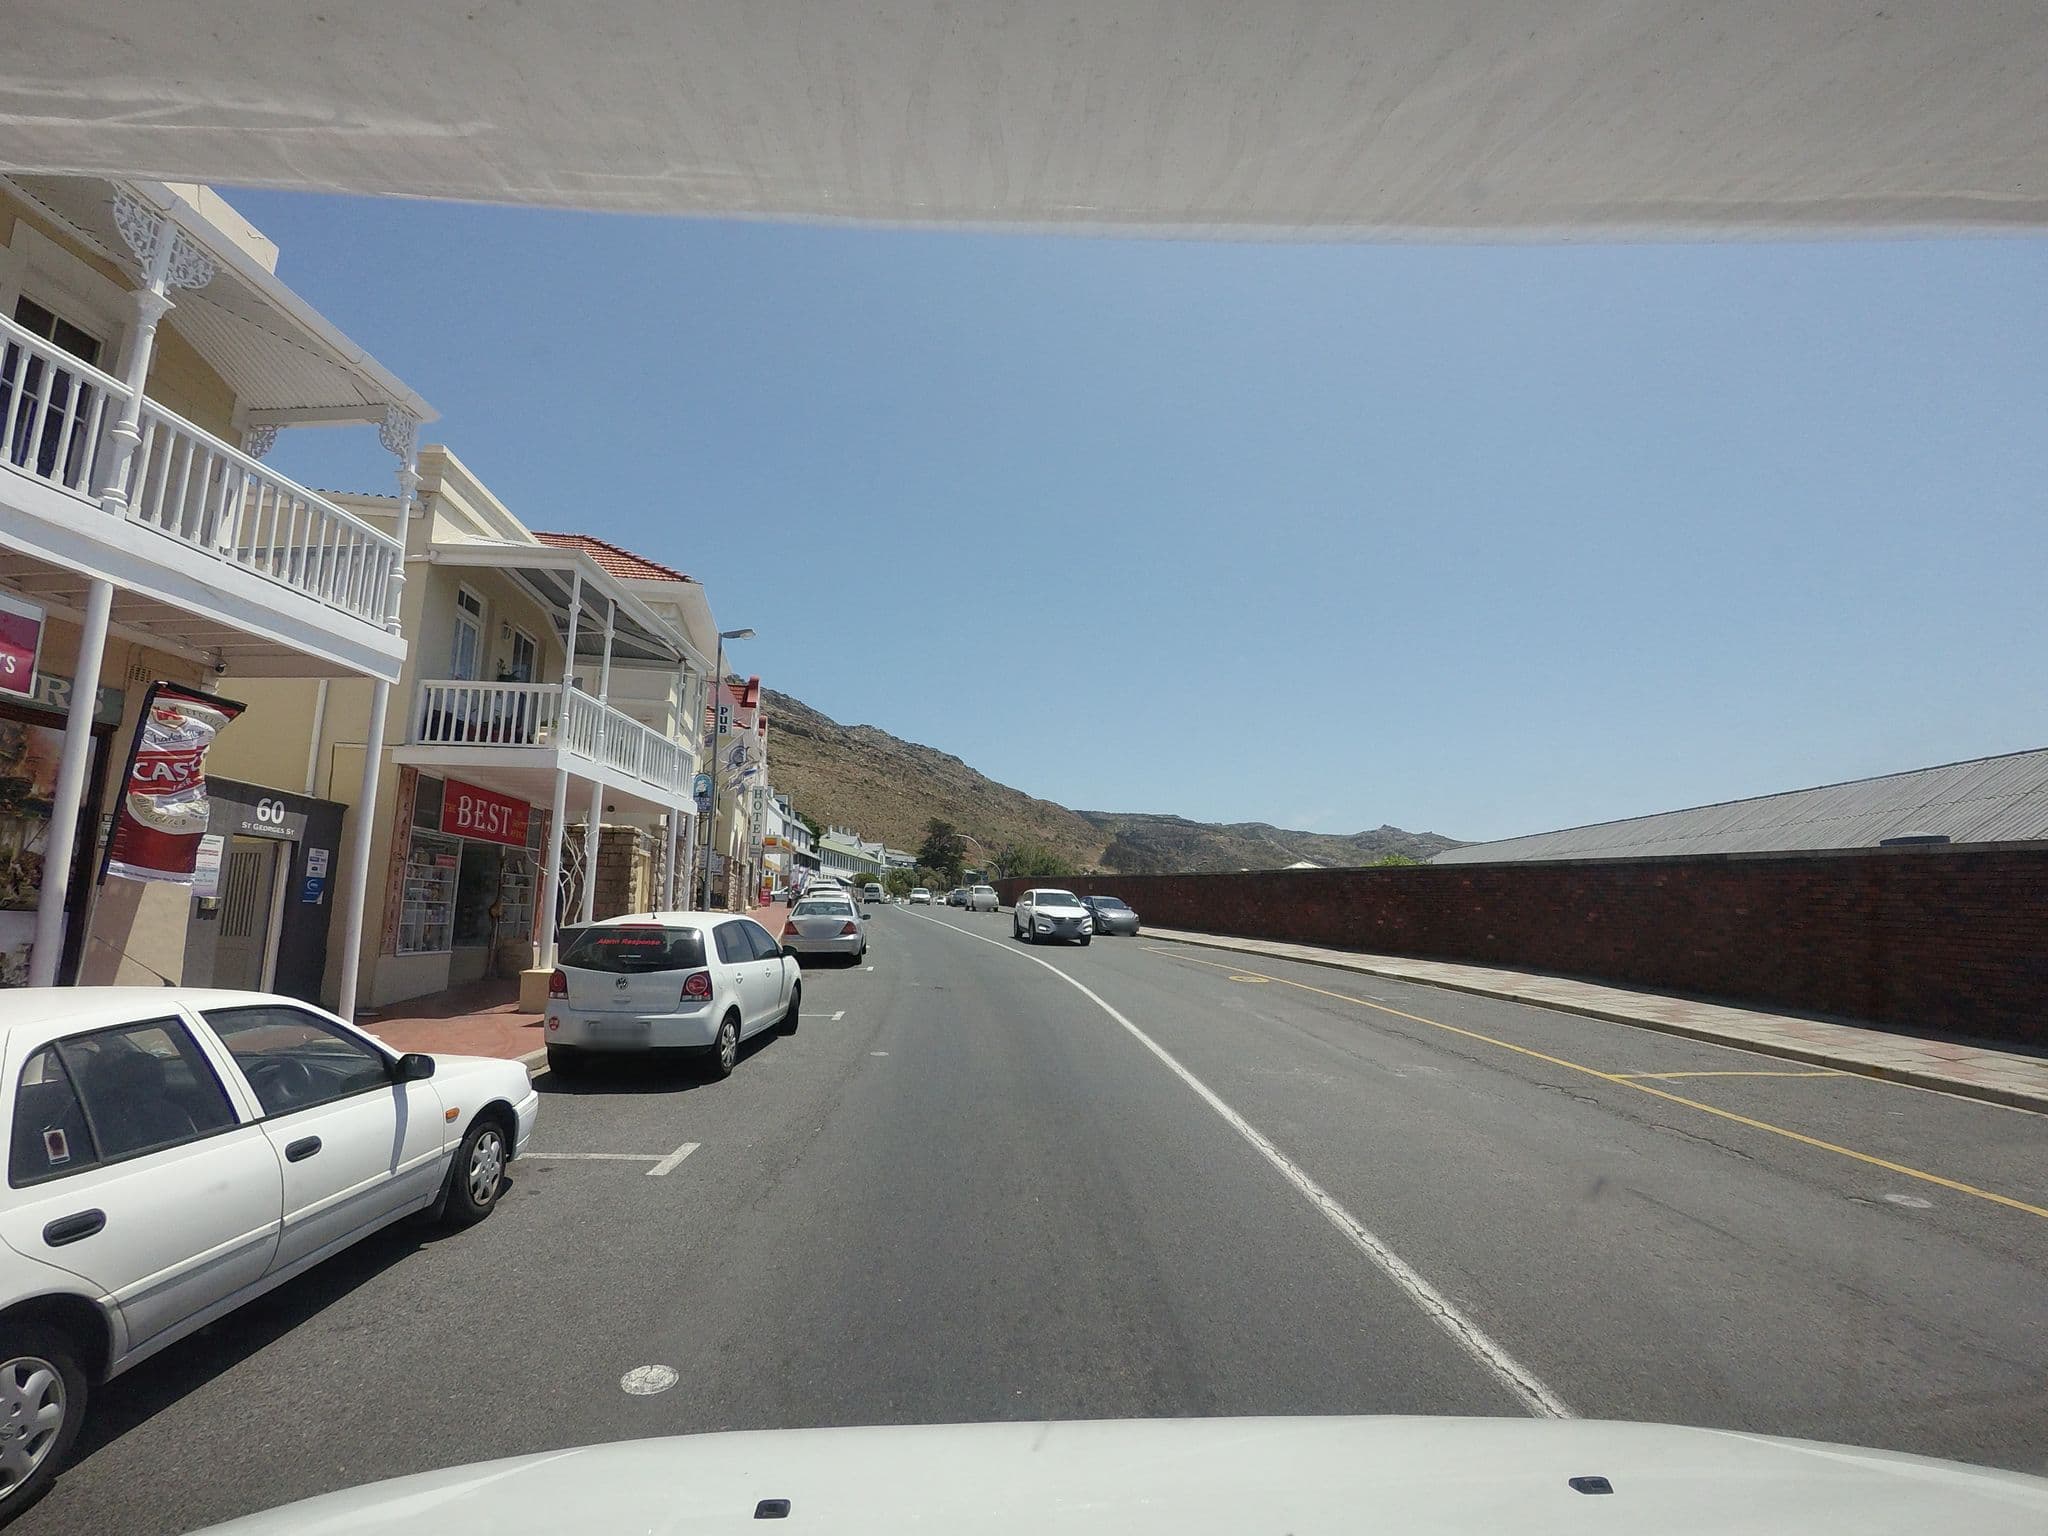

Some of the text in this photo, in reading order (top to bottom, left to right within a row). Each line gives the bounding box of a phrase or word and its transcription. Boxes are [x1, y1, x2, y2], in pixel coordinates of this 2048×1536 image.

[719, 706, 728, 734] PUB
[256, 798, 285, 824] 60
[457, 795, 512, 836] BEST
[751, 789, 762, 846] HOTEL
[621, 938, 661, 946] Response
